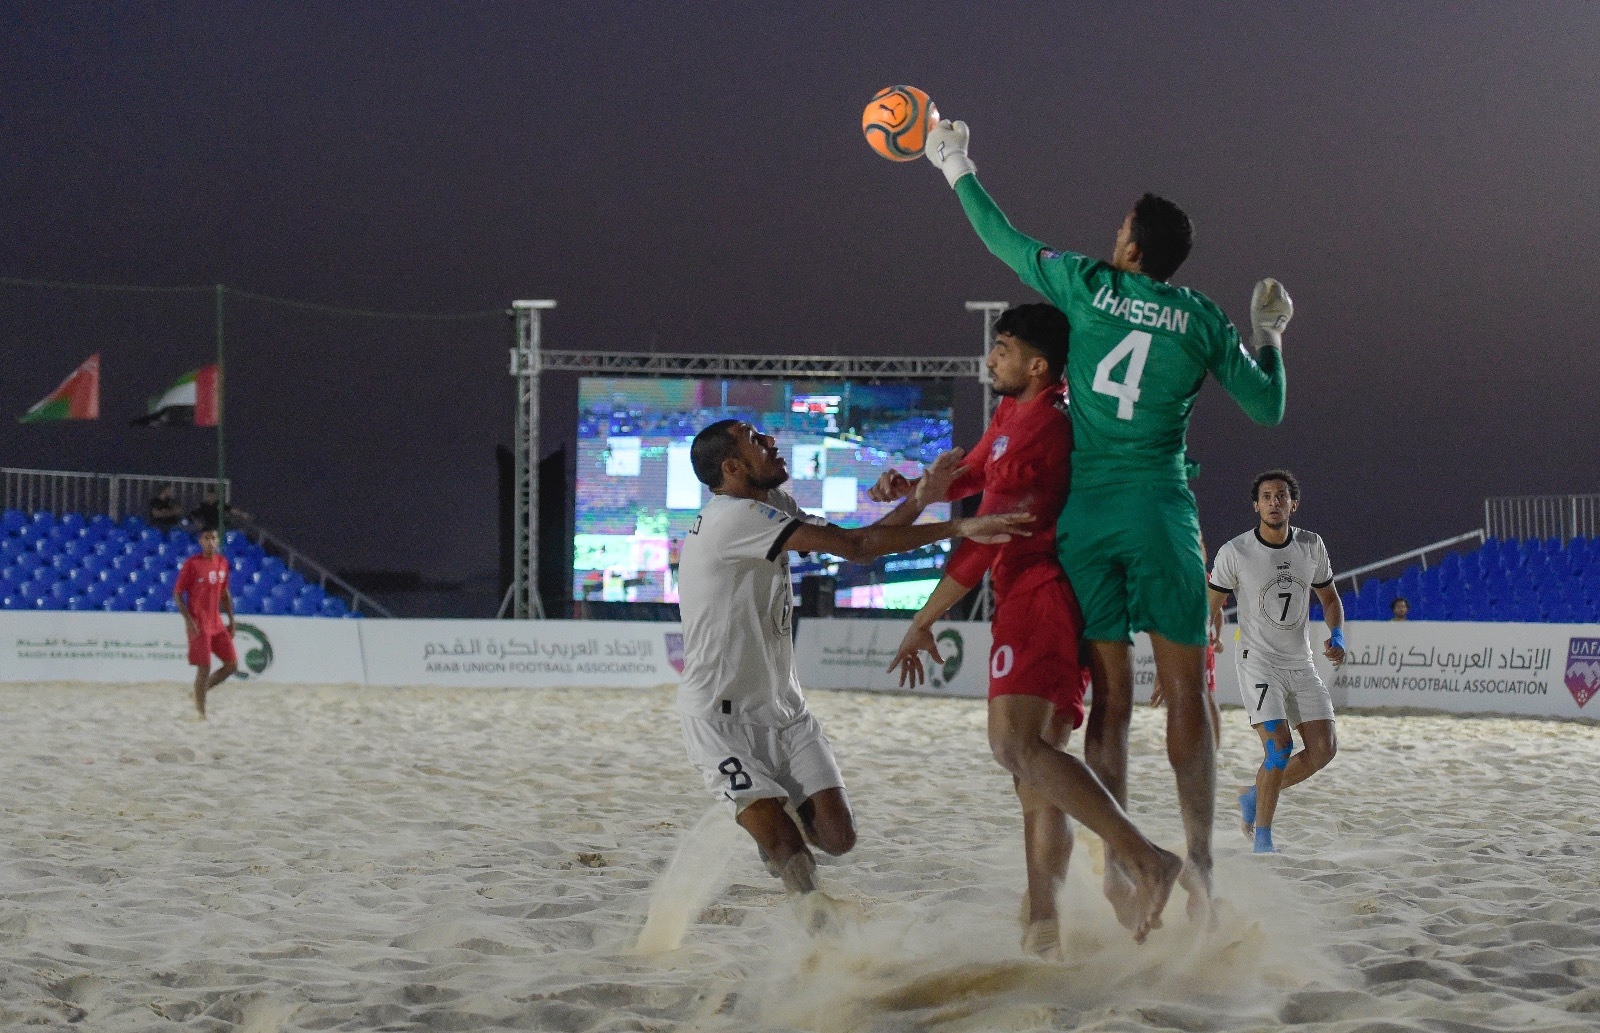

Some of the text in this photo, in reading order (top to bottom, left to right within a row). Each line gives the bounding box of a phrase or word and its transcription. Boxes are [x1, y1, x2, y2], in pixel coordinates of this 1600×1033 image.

[1092, 329, 1152, 420] 4
[1278, 592, 1292, 622] 7
[423, 638, 480, 661] القدم
[1388, 646, 1435, 673] لكرة
[1437, 647, 1493, 675] العربي
[425, 661, 657, 675] ARAB UNION FOOTBALL ASSOCIATION
[1255, 683, 1269, 711] 7
[1334, 676, 1548, 695] ARAB UNION FOOTBALL ASSOCIATION
[718, 756, 753, 791] 8
